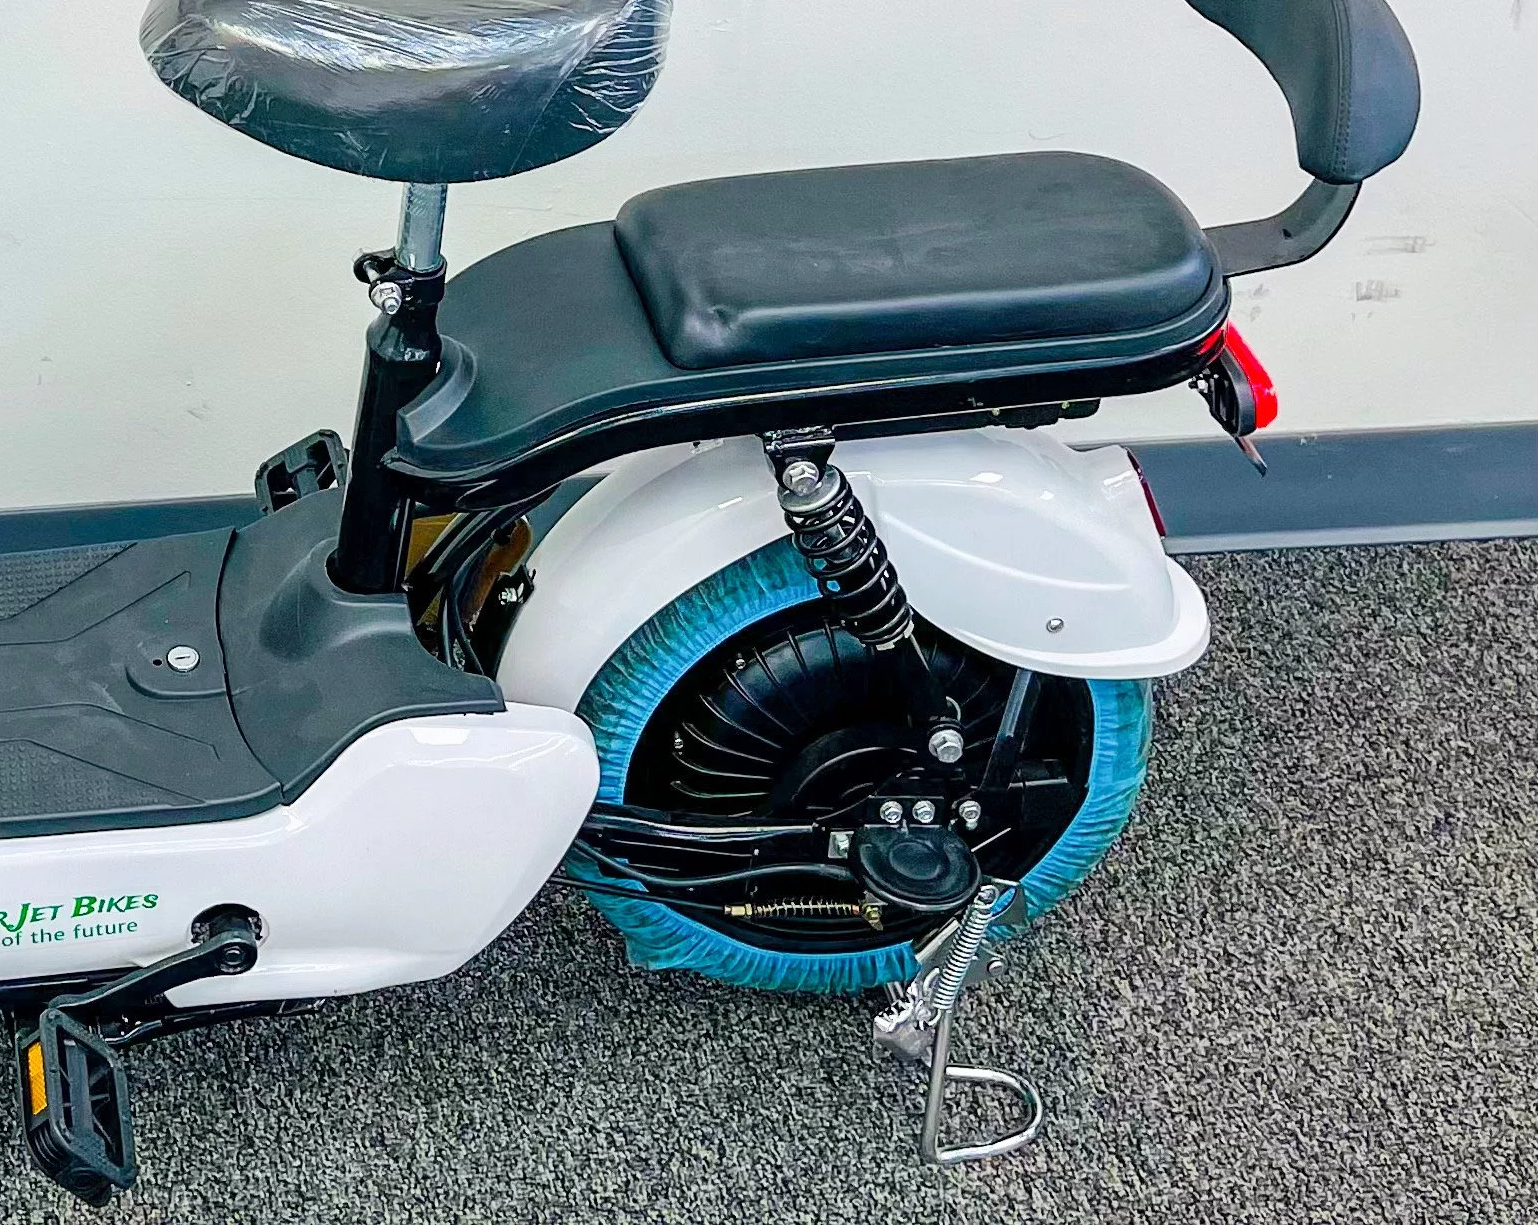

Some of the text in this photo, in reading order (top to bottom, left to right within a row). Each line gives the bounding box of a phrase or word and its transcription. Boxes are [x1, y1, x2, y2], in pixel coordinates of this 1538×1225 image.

[2, 931, 23, 947] of
[31, 928, 65, 944] the
[73, 921, 138, 939] future
